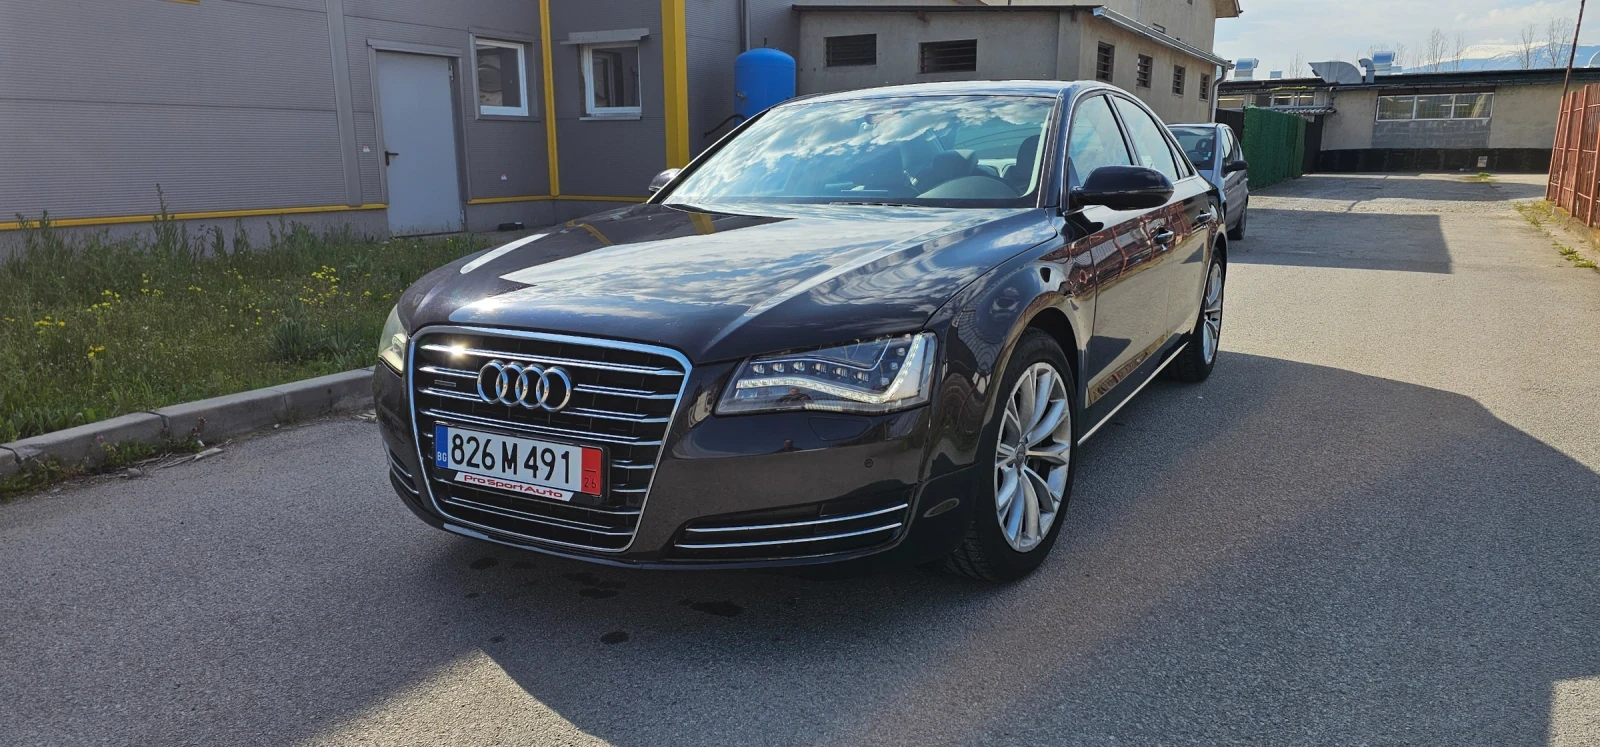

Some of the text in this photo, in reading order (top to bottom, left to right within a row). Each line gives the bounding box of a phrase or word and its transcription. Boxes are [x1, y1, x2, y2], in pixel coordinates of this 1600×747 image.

[437, 452, 447, 462] BG
[451, 433, 569, 484] 826 M 491
[584, 477, 597, 489] 26
